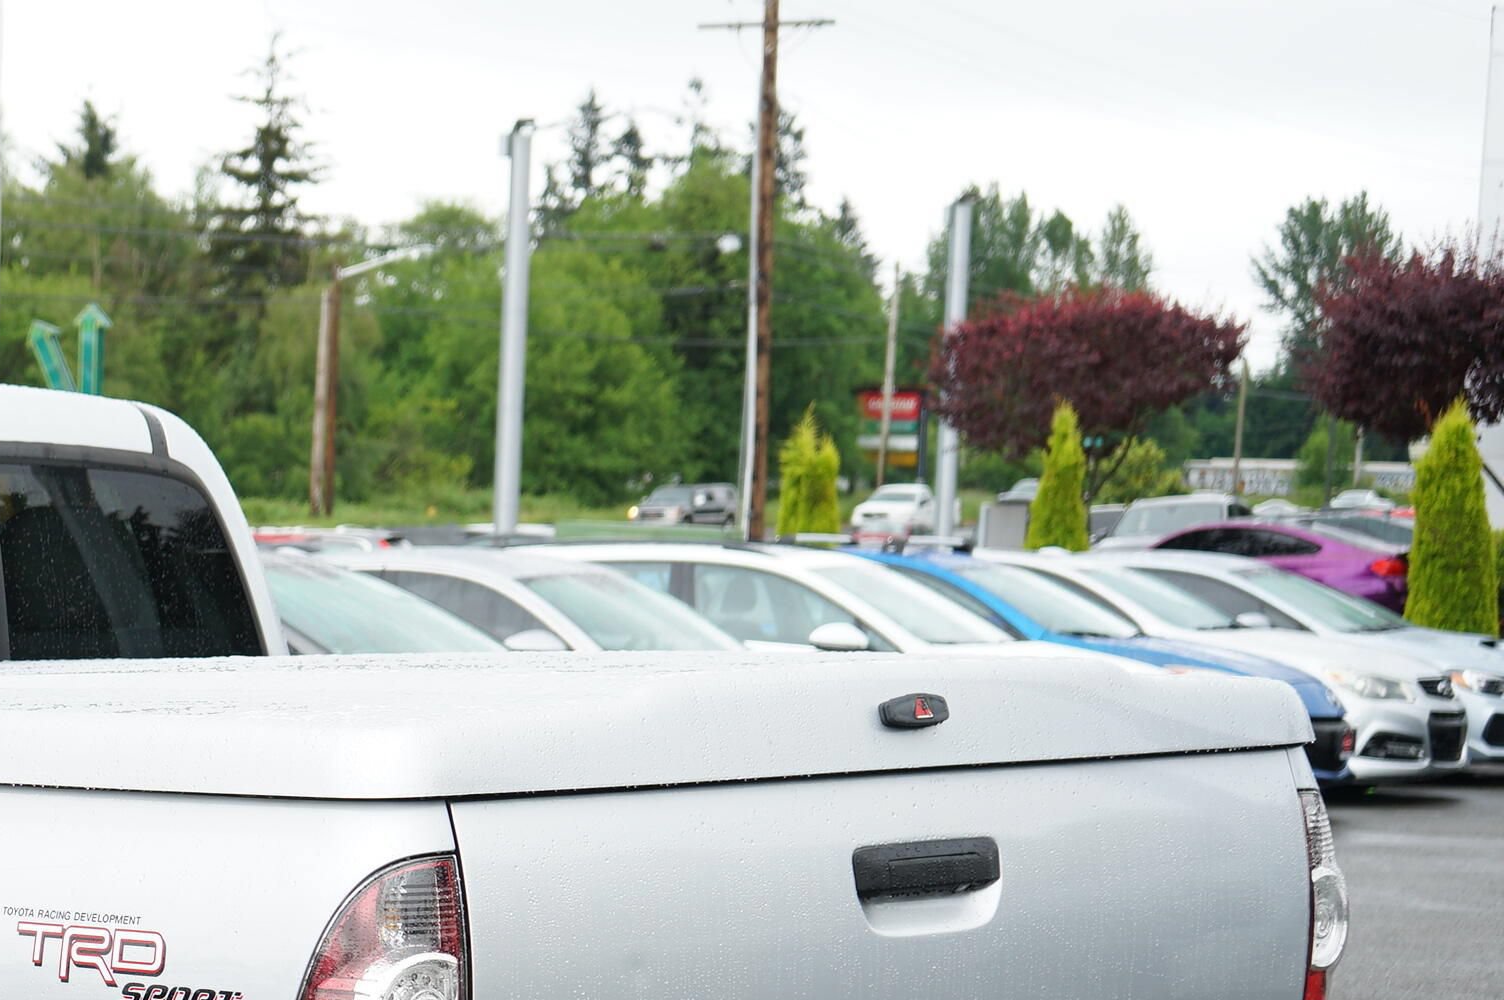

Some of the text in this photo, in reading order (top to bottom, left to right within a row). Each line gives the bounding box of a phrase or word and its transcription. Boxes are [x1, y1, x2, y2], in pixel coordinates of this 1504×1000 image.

[2, 906, 142, 926] TOYOTA RACING DEVELOPMENT
[16, 920, 167, 988] TRD
